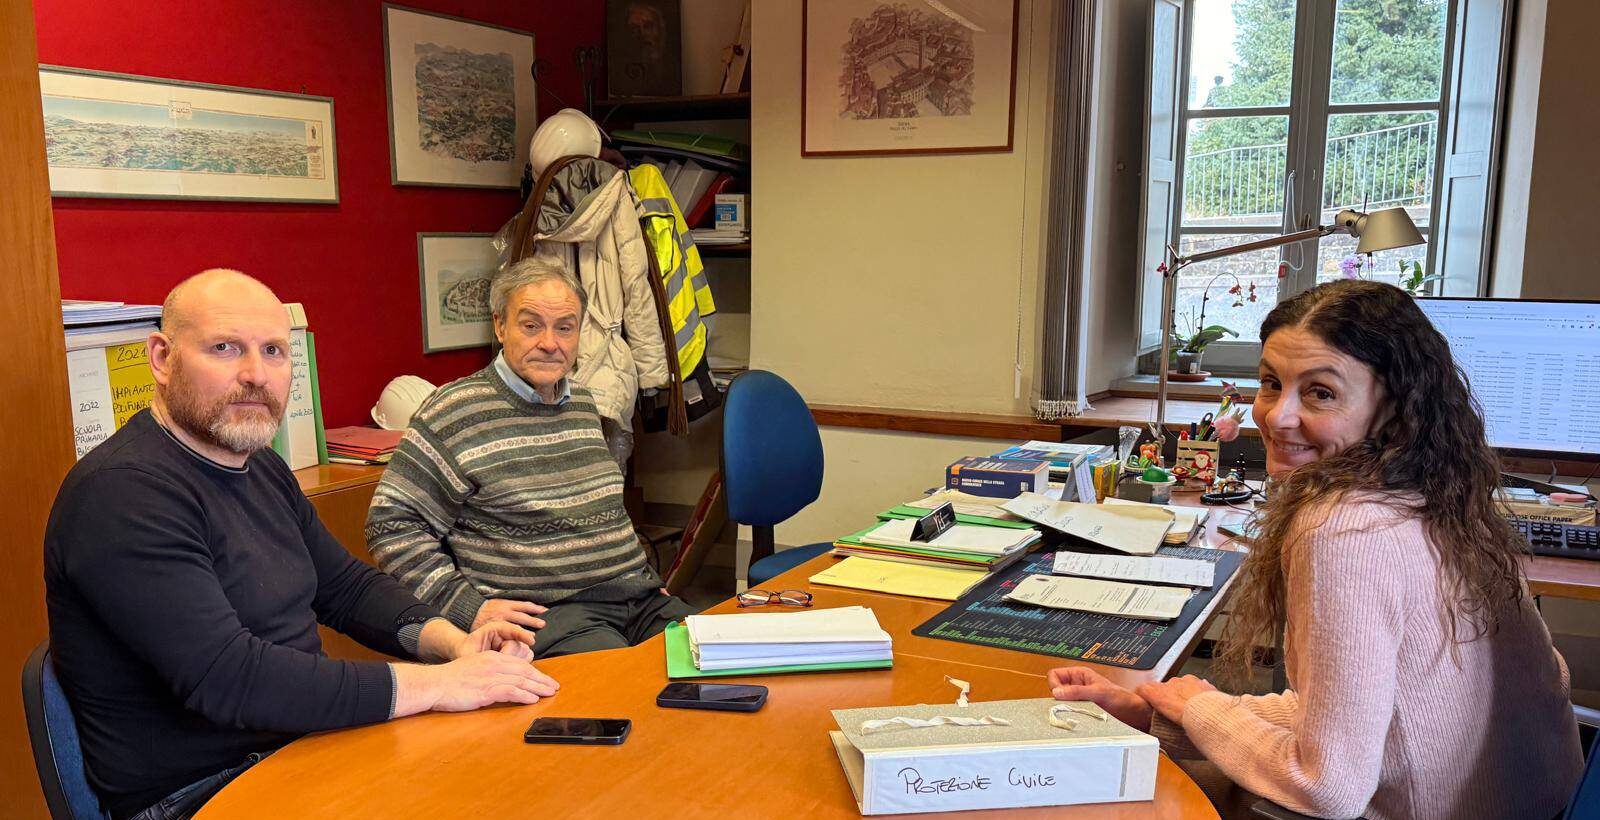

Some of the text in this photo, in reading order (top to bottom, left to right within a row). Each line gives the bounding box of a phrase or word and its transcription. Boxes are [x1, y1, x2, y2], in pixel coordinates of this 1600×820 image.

[118, 347, 147, 362] 2021
[79, 401, 99, 412] 2022
[75, 424, 102, 437] SCUOLA
[898, 767, 1056, 795] PROTEZIONE CIVILE
